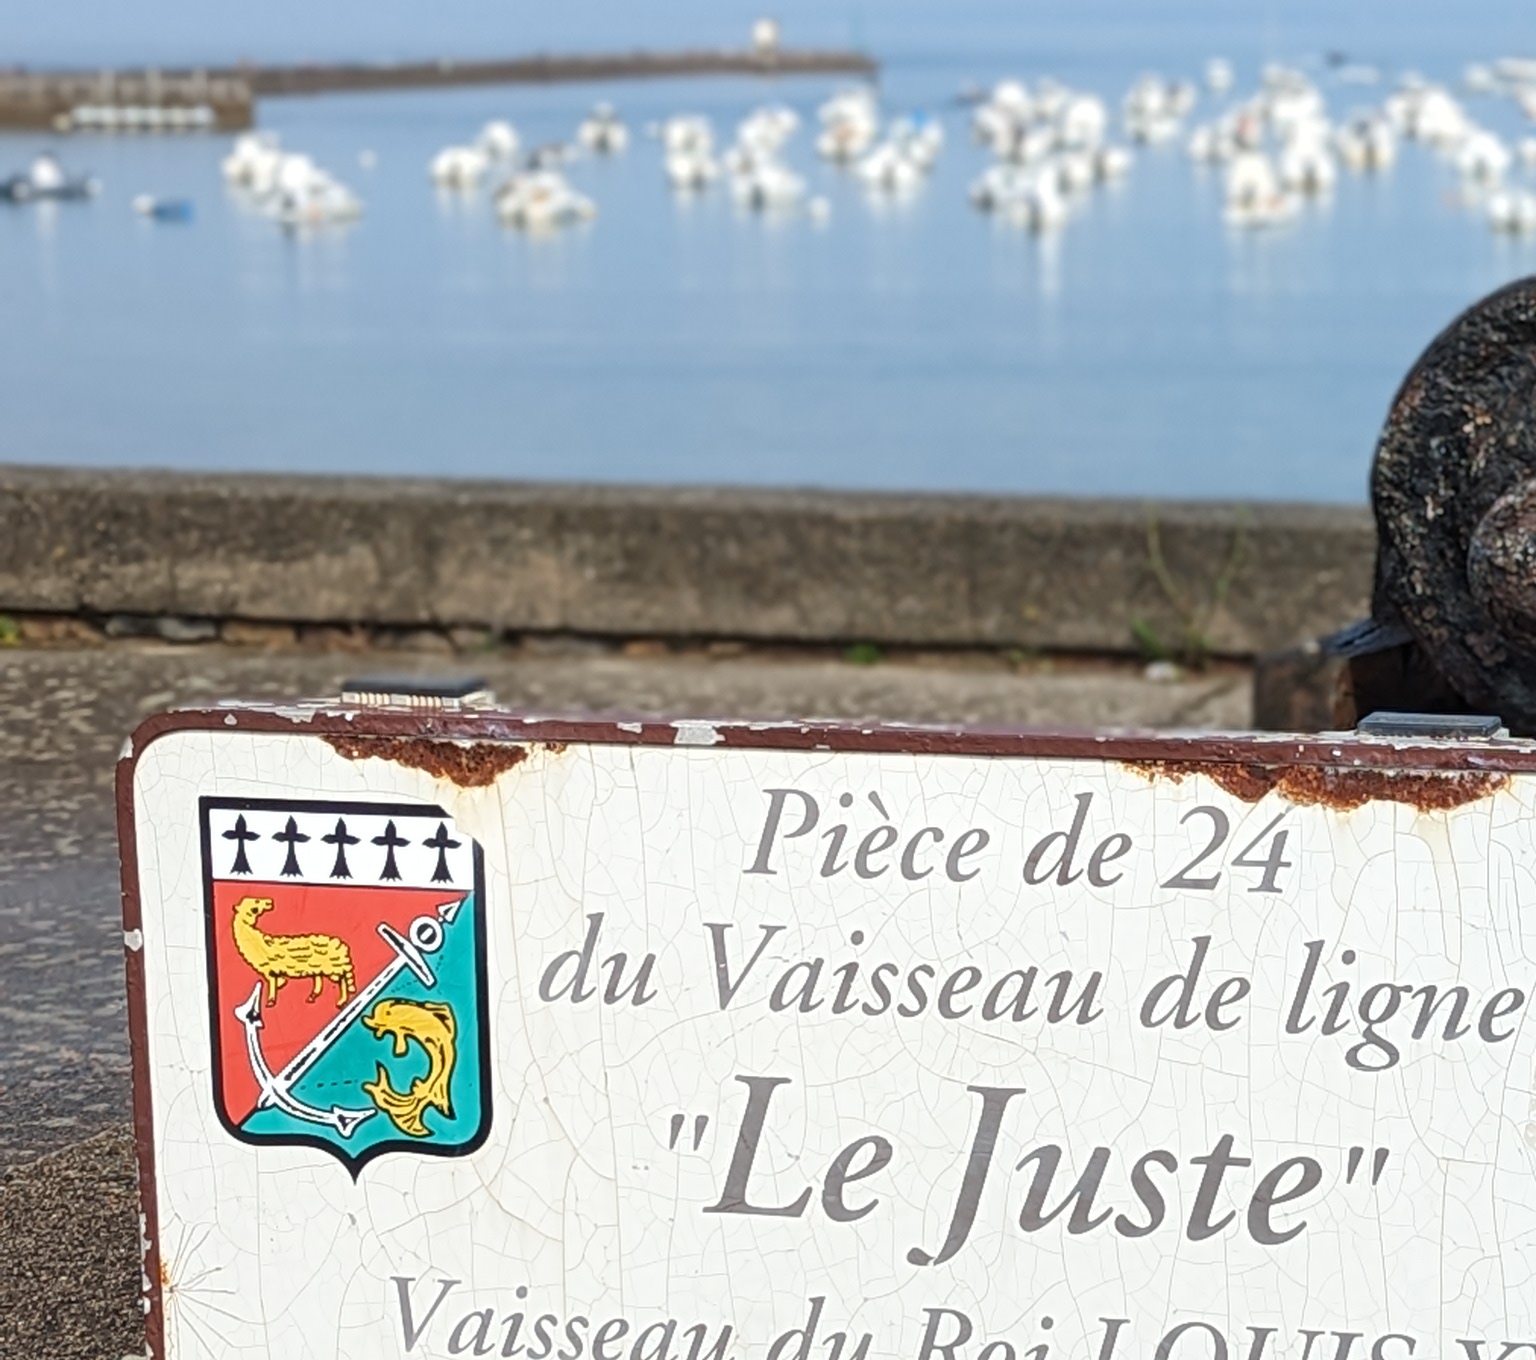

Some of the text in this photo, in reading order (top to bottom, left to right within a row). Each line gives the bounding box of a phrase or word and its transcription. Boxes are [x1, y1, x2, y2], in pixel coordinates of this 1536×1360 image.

[743, 789, 1295, 893] Pièce de 24
[539, 912, 1525, 1072] du Vaisseau de ligne
[669, 1074, 1390, 1266] "Le Juste"
